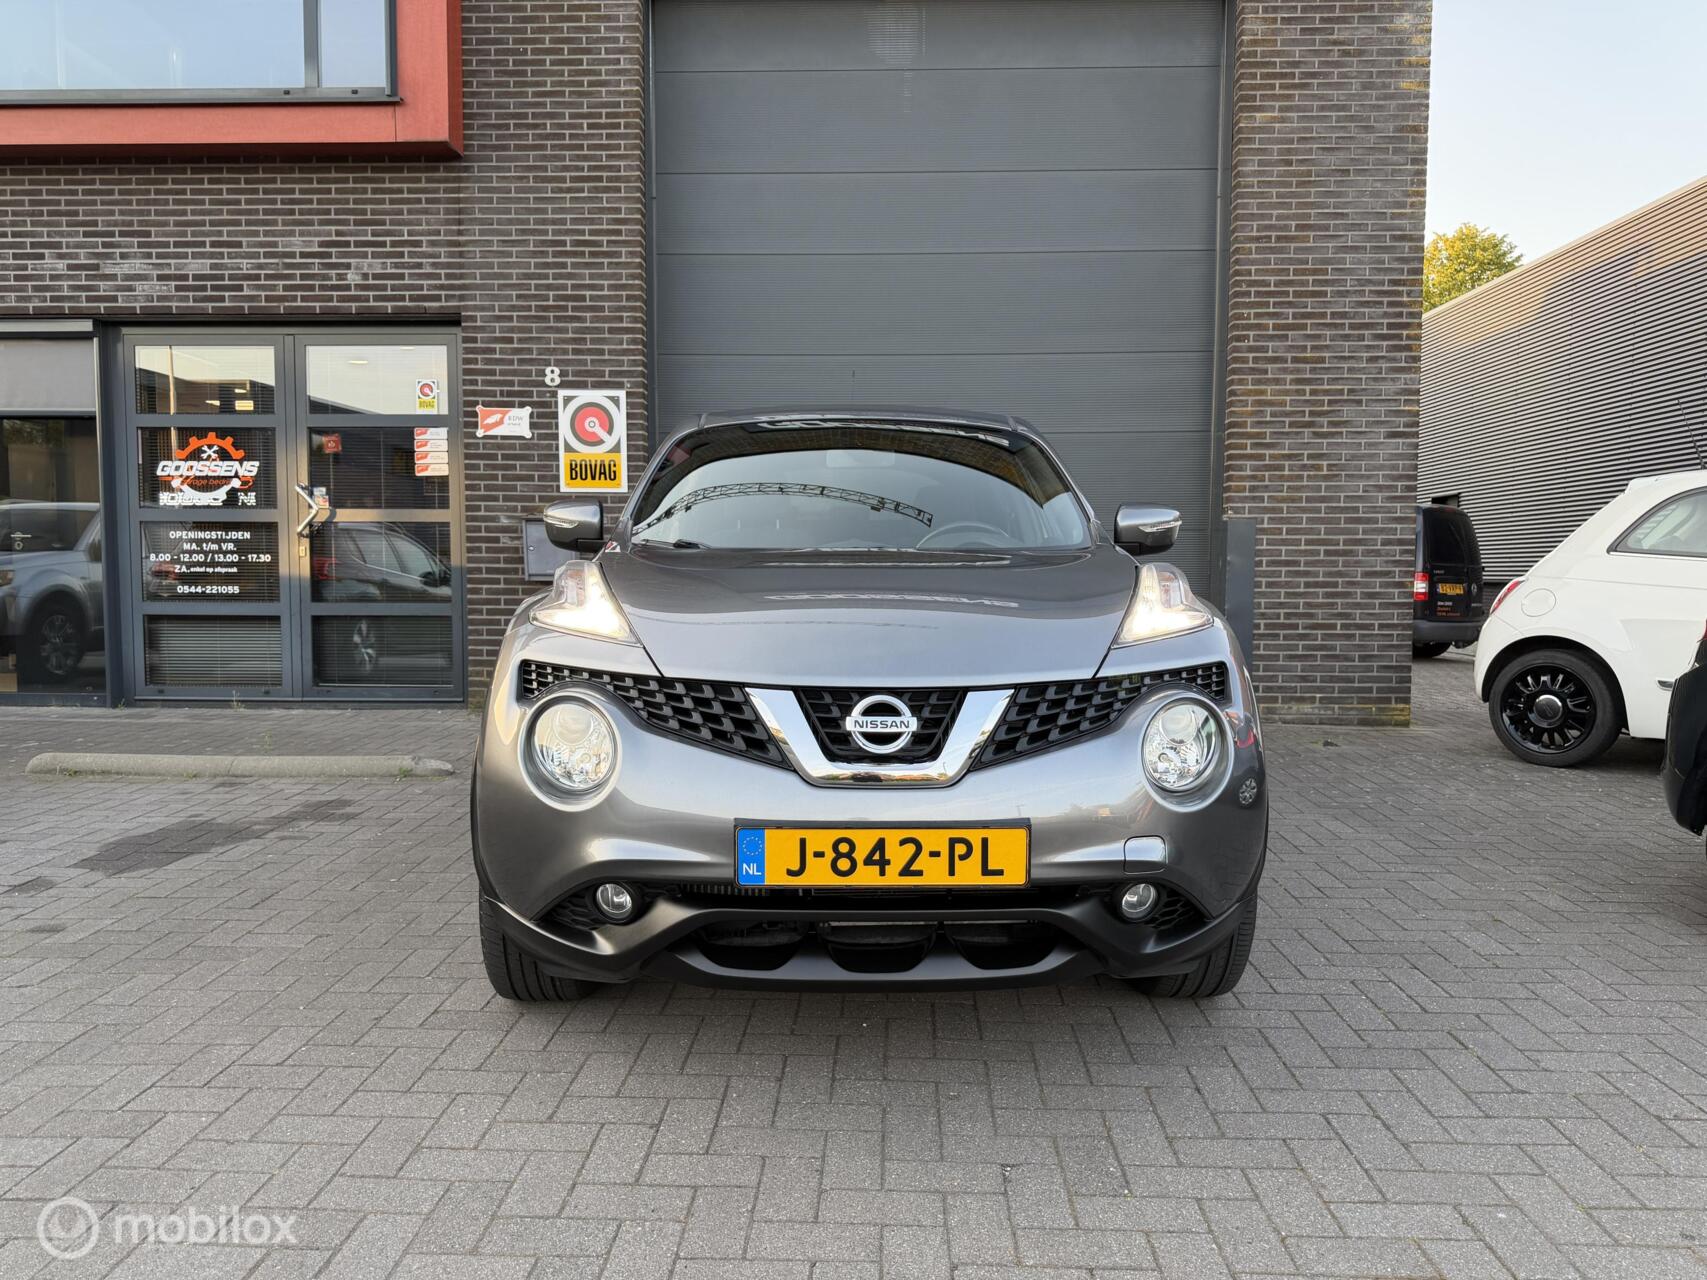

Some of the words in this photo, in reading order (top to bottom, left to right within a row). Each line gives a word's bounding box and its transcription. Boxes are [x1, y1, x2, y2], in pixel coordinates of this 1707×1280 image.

[545, 366, 561, 386] 8
[156, 460, 260, 476] GOOSSENS
[569, 459, 617, 481] BOVAG
[169, 531, 251, 540] OPENINGSTIJDEN
[183, 542, 200, 551] MA.
[203, 542, 219, 551] t/m
[221, 542, 237, 551] VR.
[149, 553, 172, 562] 8.00
[180, 553, 205, 562] 12.00
[214, 553, 239, 562] 13.00
[247, 554, 272, 563] 17.30
[177, 585, 240, 594] 0544-221055
[854, 720, 910, 729] NISSAN
[742, 862, 762, 876] NL
[786, 836, 1005, 878] J-842-PL
